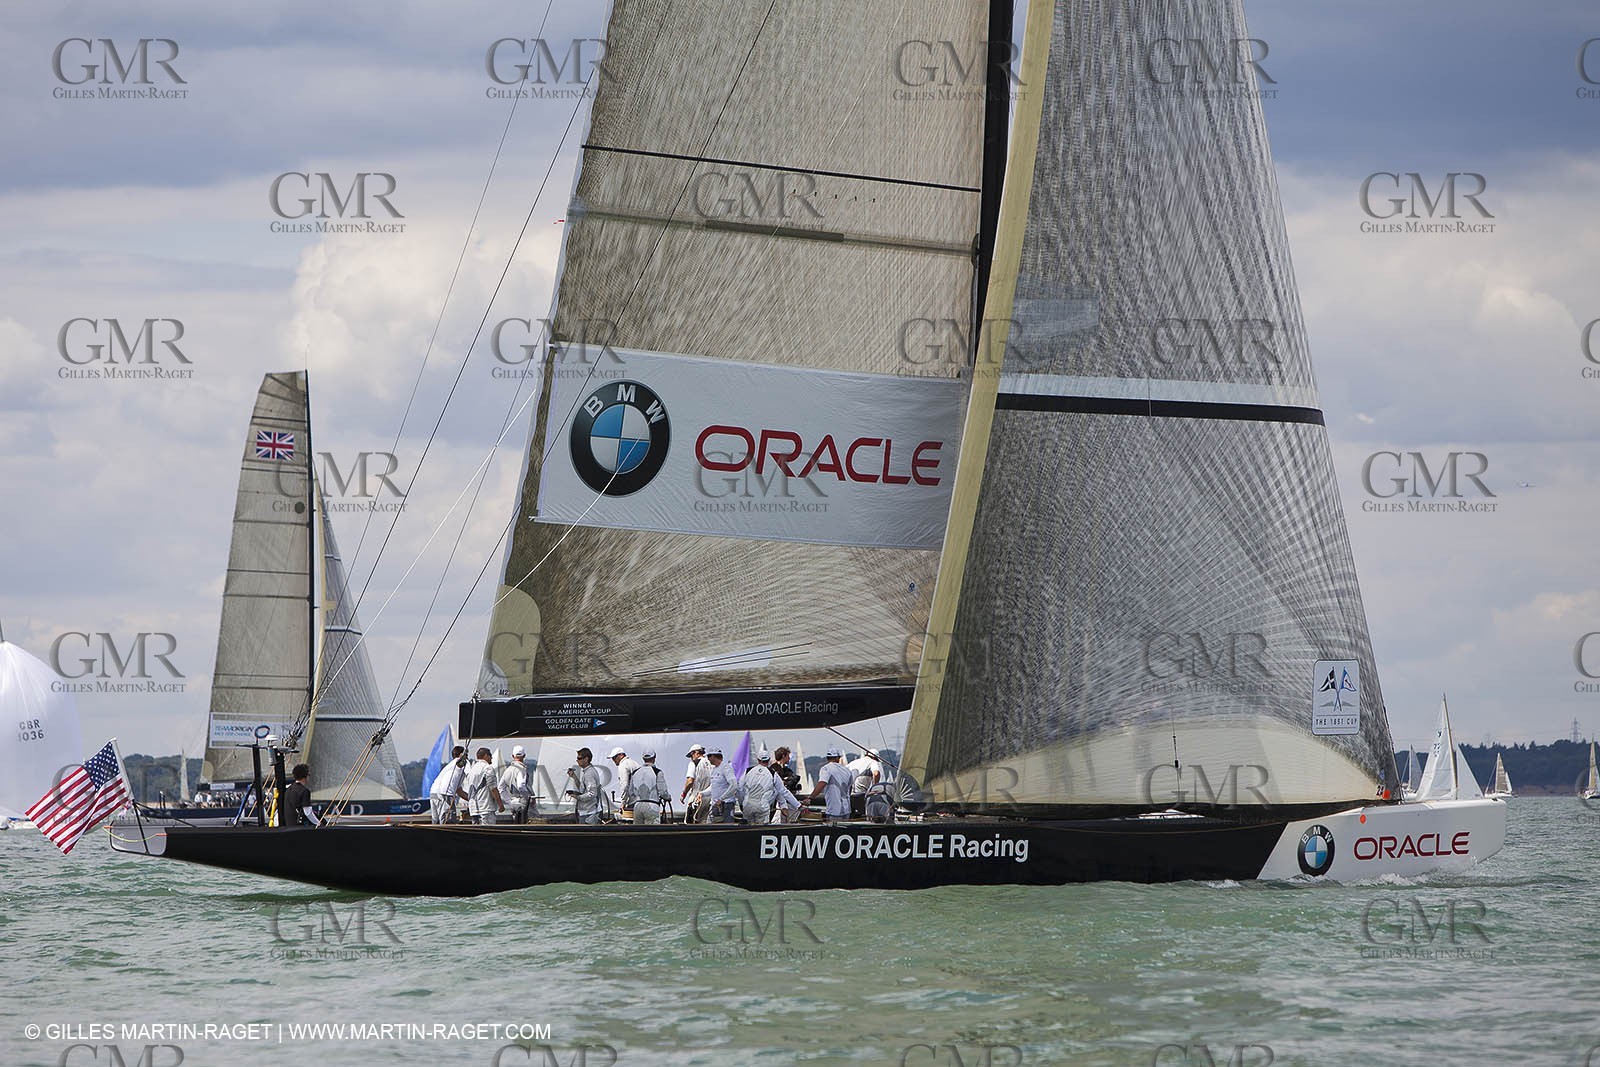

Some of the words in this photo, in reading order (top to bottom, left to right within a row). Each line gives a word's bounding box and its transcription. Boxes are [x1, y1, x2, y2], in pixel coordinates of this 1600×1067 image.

[583, 384, 665, 424] BMW
[694, 424, 944, 487] ORACLE
[725, 704, 754, 716] BMW
[756, 701, 801, 715] ORACLE
[804, 701, 839, 714] Racing
[760, 835, 830, 859] BMW
[834, 834, 944, 859] ORACLE
[949, 833, 1029, 863] Racing
[1301, 826, 1333, 844] BMW
[1353, 831, 1470, 860] ORACLE
